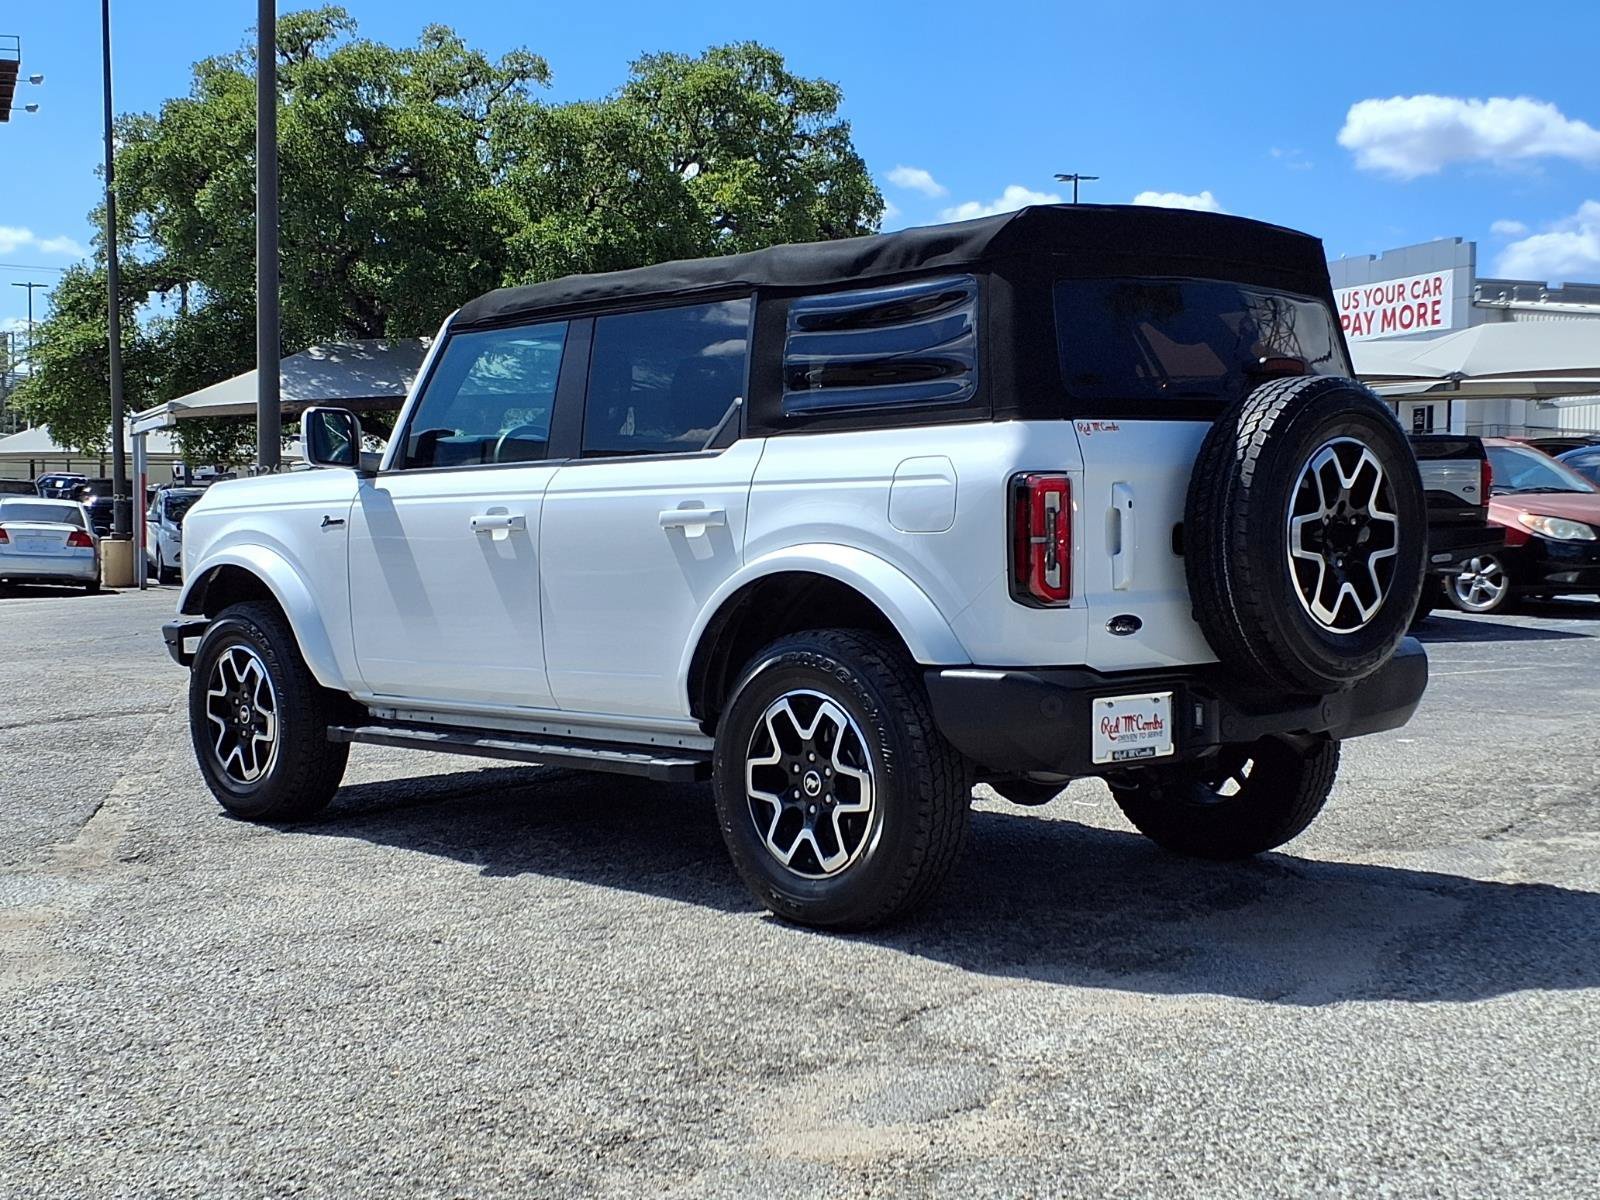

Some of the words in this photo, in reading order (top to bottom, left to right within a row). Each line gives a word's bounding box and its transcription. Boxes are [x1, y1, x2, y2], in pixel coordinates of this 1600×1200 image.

[1342, 291, 1359, 310] US
[1364, 284, 1405, 307] YOUR
[1411, 277, 1442, 299] CAR
[1340, 310, 1375, 336] PAY
[1381, 300, 1441, 333] MORE
[1101, 716, 1120, 741] Red
